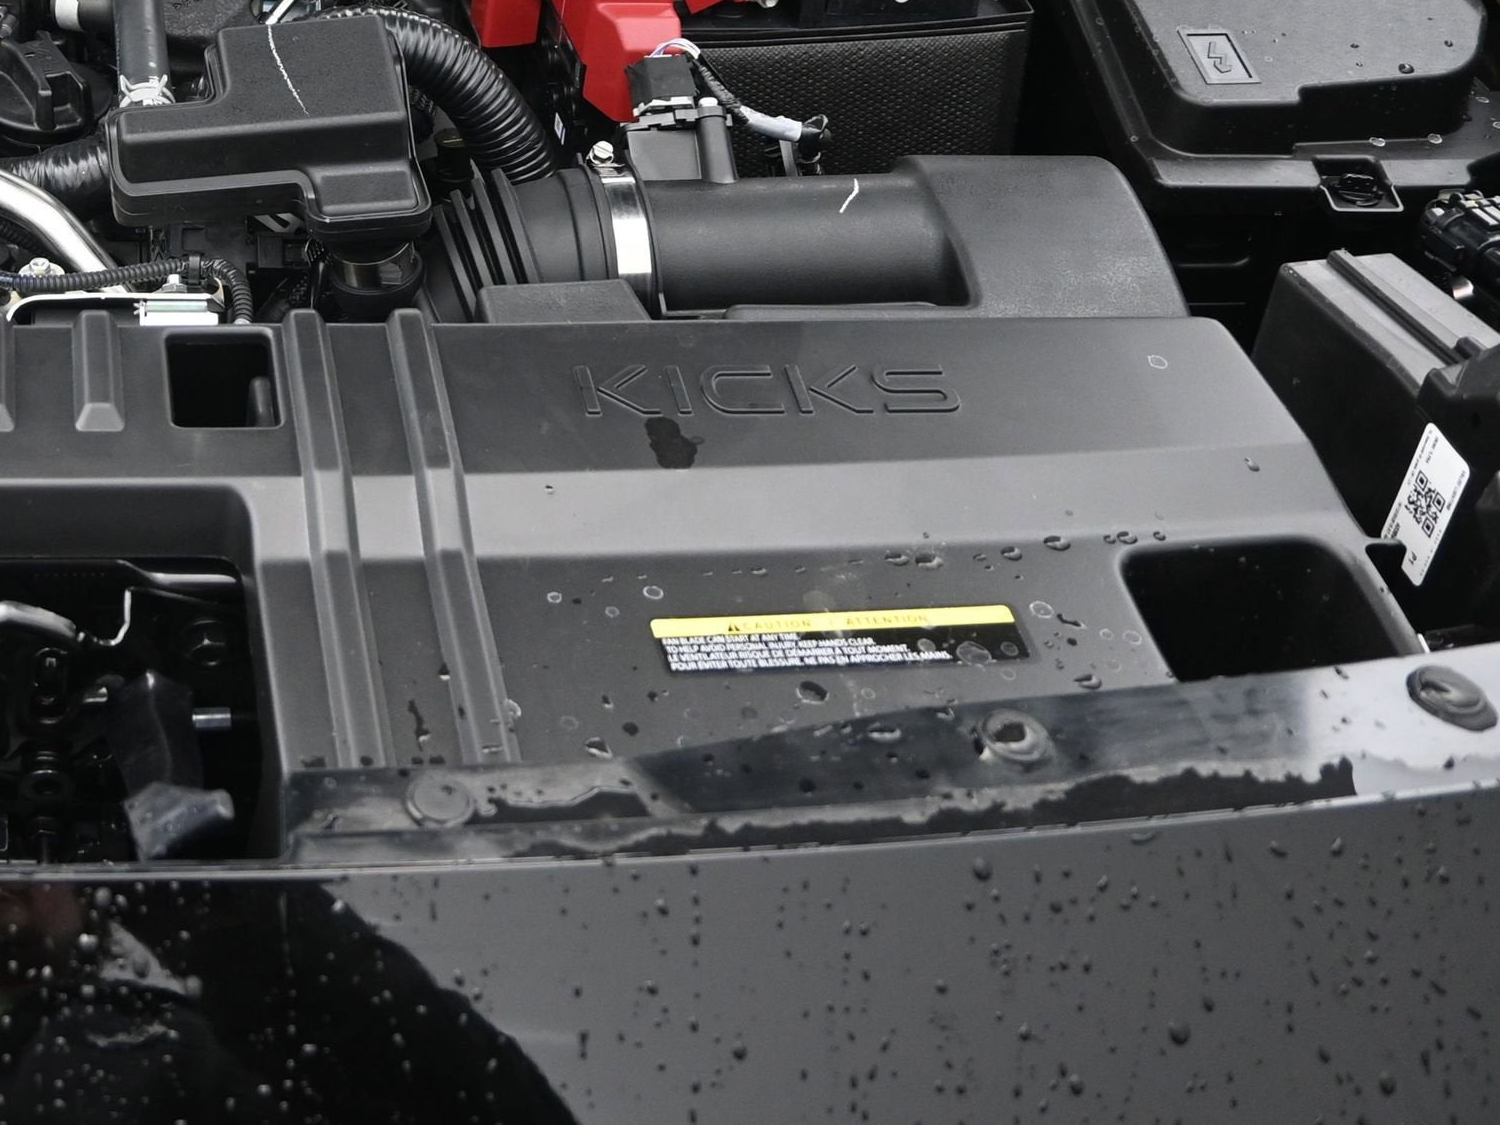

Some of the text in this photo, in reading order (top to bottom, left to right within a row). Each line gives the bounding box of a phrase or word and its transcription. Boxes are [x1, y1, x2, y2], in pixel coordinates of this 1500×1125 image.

[572, 362, 961, 418] KICKS
[743, 615, 929, 630] CAUTION ATTENTION
[662, 636, 679, 645] FAN
[679, 636, 705, 645] BLADE
[706, 635, 725, 644] CAN
[726, 634, 750, 643] START
[750, 634, 760, 642] AT
[761, 633, 778, 642] ANY
[665, 645, 678, 653] TO
[679, 644, 699, 653] HELP
[700, 643, 726, 652] AVOID
[726, 642, 768, 651] PERSONAL
[798, 640, 818, 649] KEEP
[819, 638, 847, 648] HANDS
[667, 653, 679, 662] LE
[680, 652, 738, 661] VENTILATEUR
[738, 650, 771, 660] RISQUE
[771, 649, 784, 658] DE
[843, 645, 866, 654] TOUT
[670, 661, 697, 671] POUR
[728, 659, 758, 668] TOUTE
[804, 656, 818, 666] NE
[818, 655, 836, 665] PAS
[849, 653, 904, 663] APPROCHER
